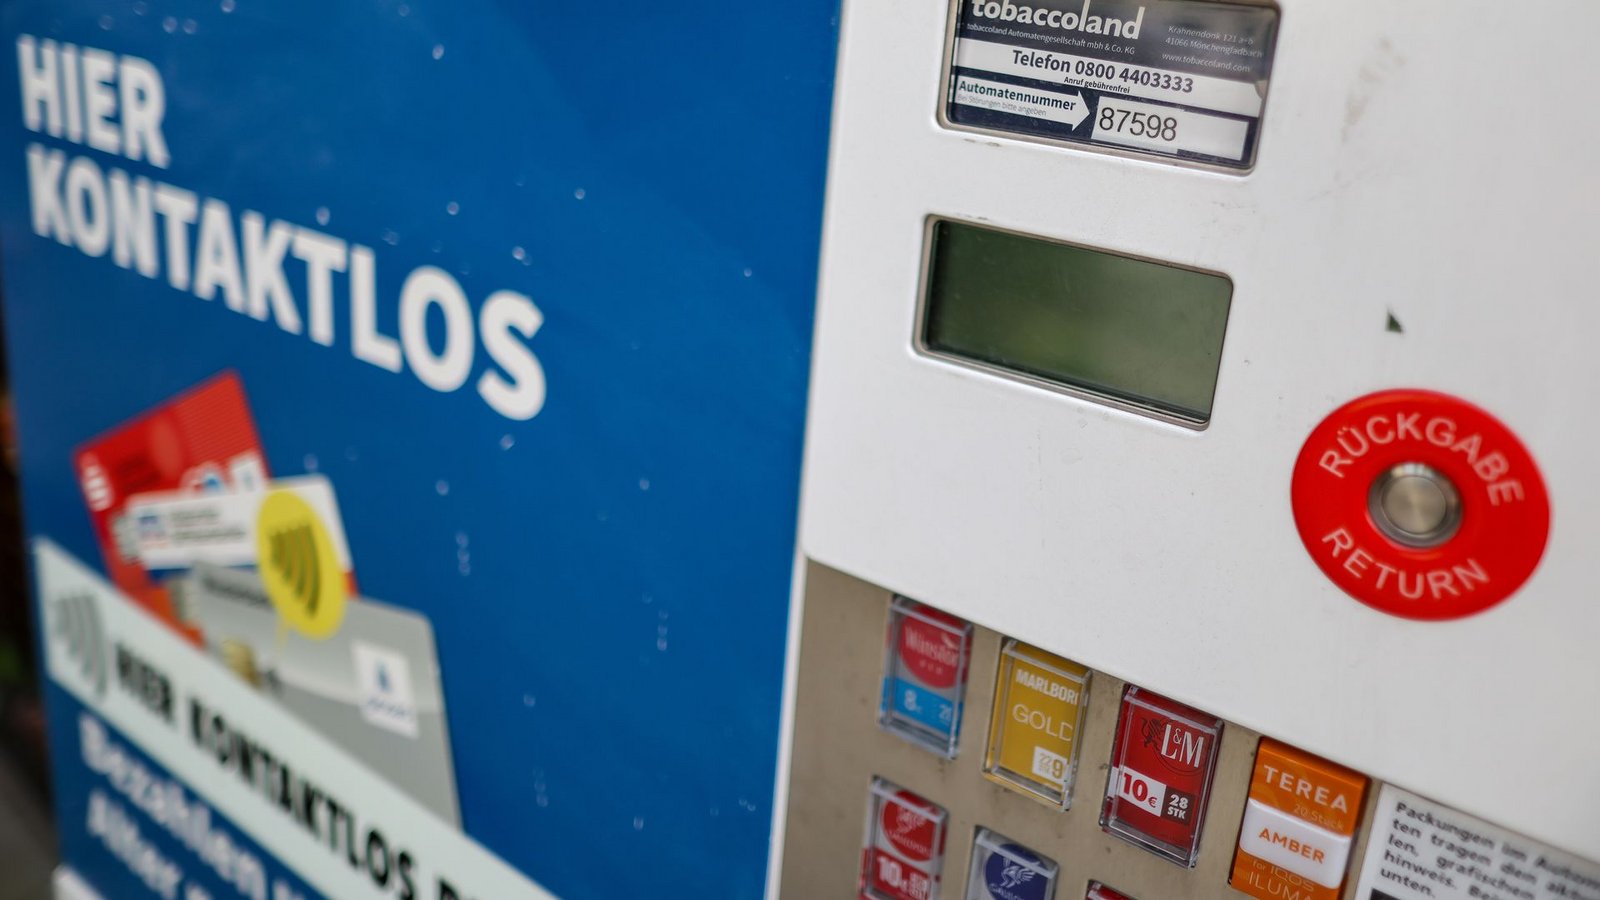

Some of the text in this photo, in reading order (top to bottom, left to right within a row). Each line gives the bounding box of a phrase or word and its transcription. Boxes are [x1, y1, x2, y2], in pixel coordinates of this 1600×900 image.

[972, 0, 1145, 40] tobaccoland
[1223, 33, 1237, 43] 121
[967, 23, 1008, 36] tobaccoland
[1008, 29, 1086, 48] Automatengesellschaft
[1104, 43, 1110, 51] &
[1111, 44, 1123, 54] Co.
[1124, 46, 1135, 55] KG
[1165, 36, 1189, 48] 41066
[1012, 50, 1194, 93] Telefon 0800 4403333
[1063, 76, 1131, 94] Anruf gebührenfrei
[17, 33, 170, 169] HIER
[958, 80, 1076, 111] Automatennummer
[968, 95, 1001, 108] Störungen
[1002, 101, 1017, 111] bitte
[1017, 105, 1047, 116] angeben
[1099, 107, 1177, 141] 87598
[26, 142, 547, 421] KONTAKTLOS
[1318, 412, 1525, 506] RÜCKGABE
[1321, 528, 1491, 599] RETURN
[1160, 723, 1205, 768] L&M
[1169, 793, 1189, 810] 28
[1263, 763, 1348, 814] TEREA
[1167, 806, 1187, 820] STK
[1395, 802, 1496, 849] Packungen
[1258, 828, 1326, 865] AMBER
[1392, 818, 1421, 838] ten
[1430, 834, 1492, 866] tragen
[1252, 859, 1316, 893] for IQOS
[1380, 867, 1436, 898] unten.
[1383, 849, 1458, 889] hinweis.
